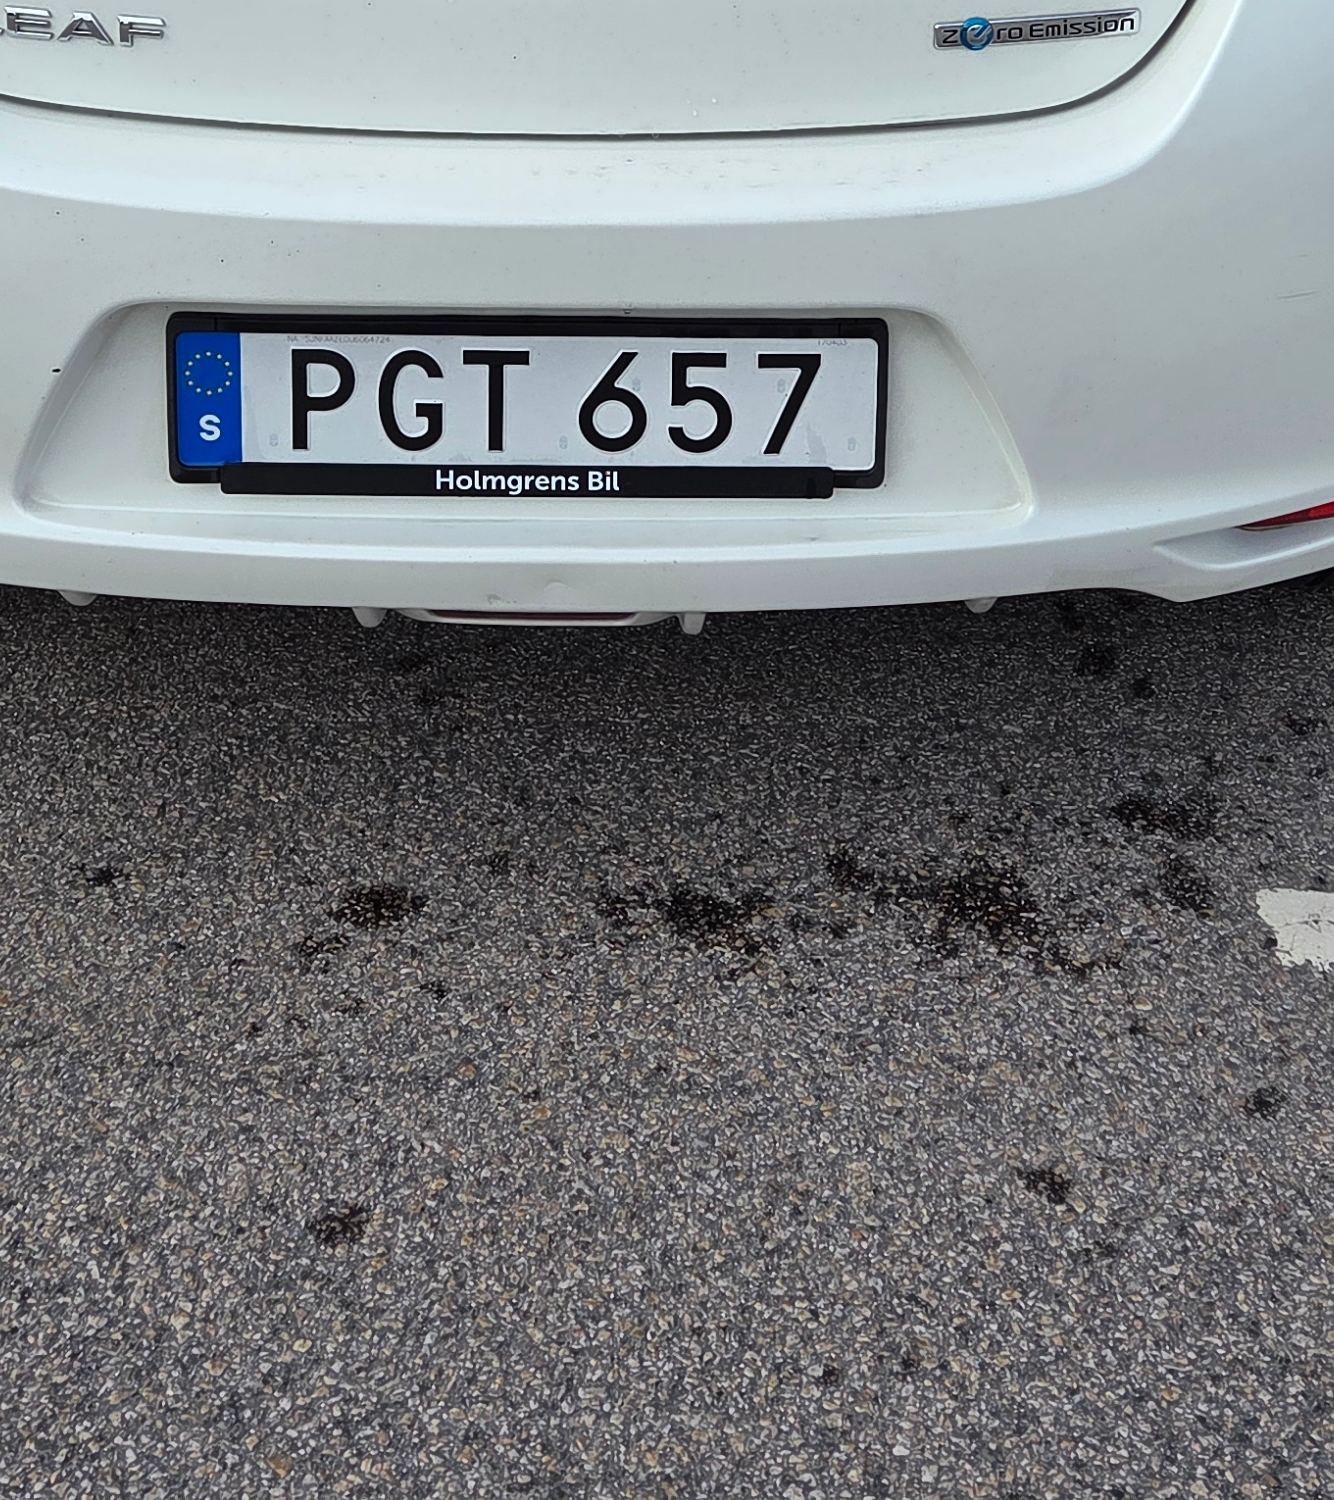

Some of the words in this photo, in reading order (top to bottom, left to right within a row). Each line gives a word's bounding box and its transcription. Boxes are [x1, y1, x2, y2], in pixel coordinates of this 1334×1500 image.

[1029, 16, 1135, 38] Emission
[291, 349, 530, 452] PGT
[578, 351, 822, 454] 657
[199, 414, 221, 441] S
[436, 470, 580, 495] Holmgrens
[588, 471, 620, 491] Bil
